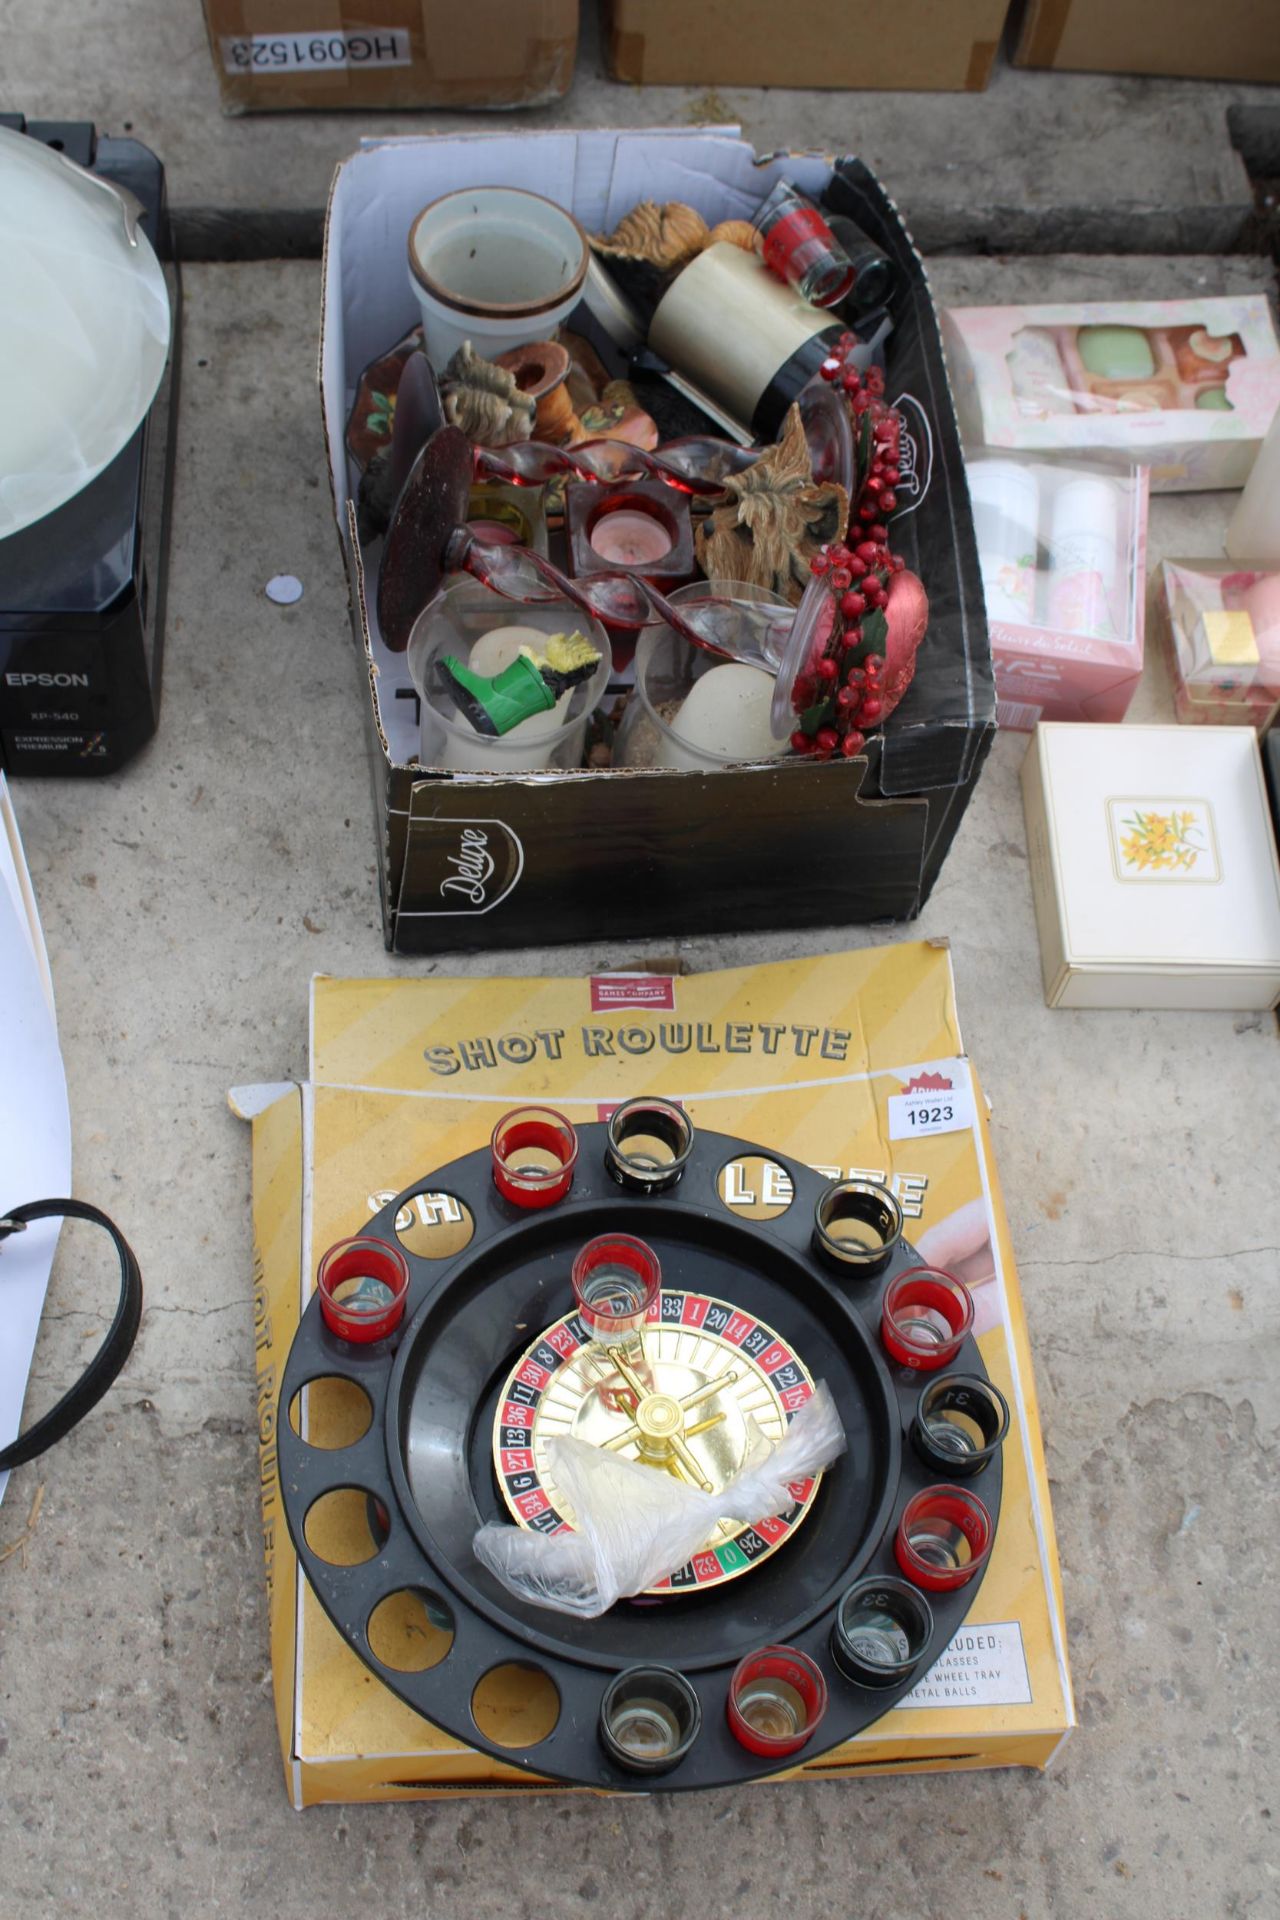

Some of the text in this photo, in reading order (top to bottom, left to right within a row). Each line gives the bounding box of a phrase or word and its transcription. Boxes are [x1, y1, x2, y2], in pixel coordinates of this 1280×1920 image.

[231, 36, 398, 66] HG091523
[5, 673, 89, 687] EPSON
[31, 712, 79, 721] XP-540
[15, 735, 84, 744] EXPRESSION
[16, 743, 69, 751] PREMIUM
[440, 828, 495, 904] Deluxe
[598, 989, 626, 997] GAMES
[423, 1022, 852, 1077] SHOT ROULETTE
[907, 1105, 954, 1126] 1923
[662, 1297, 683, 1317] 33
[689, 1303, 701, 1321] 1
[706, 1307, 728, 1330] 20
[725, 1316, 747, 1340] 14
[551, 1329, 574, 1351] 23
[745, 1331, 769, 1355] 31
[537, 1348, 554, 1365] 8
[764, 1350, 782, 1366] 9
[521, 1363, 544, 1385] 30
[775, 1367, 798, 1389] 22
[513, 1384, 535, 1405] 11
[506, 1405, 528, 1426] 36
[506, 1428, 526, 1447] 13
[506, 1451, 528, 1470] 27
[520, 1493, 544, 1514] 34
[533, 1512, 560, 1533] 17
[738, 1531, 763, 1555] 26
[695, 1555, 718, 1577] 32
[723, 1547, 738, 1565] 0
[934, 1671, 971, 1683] WHEEL
[975, 1669, 1001, 1681] TRAY
[944, 1686, 977, 1697] BALLS
